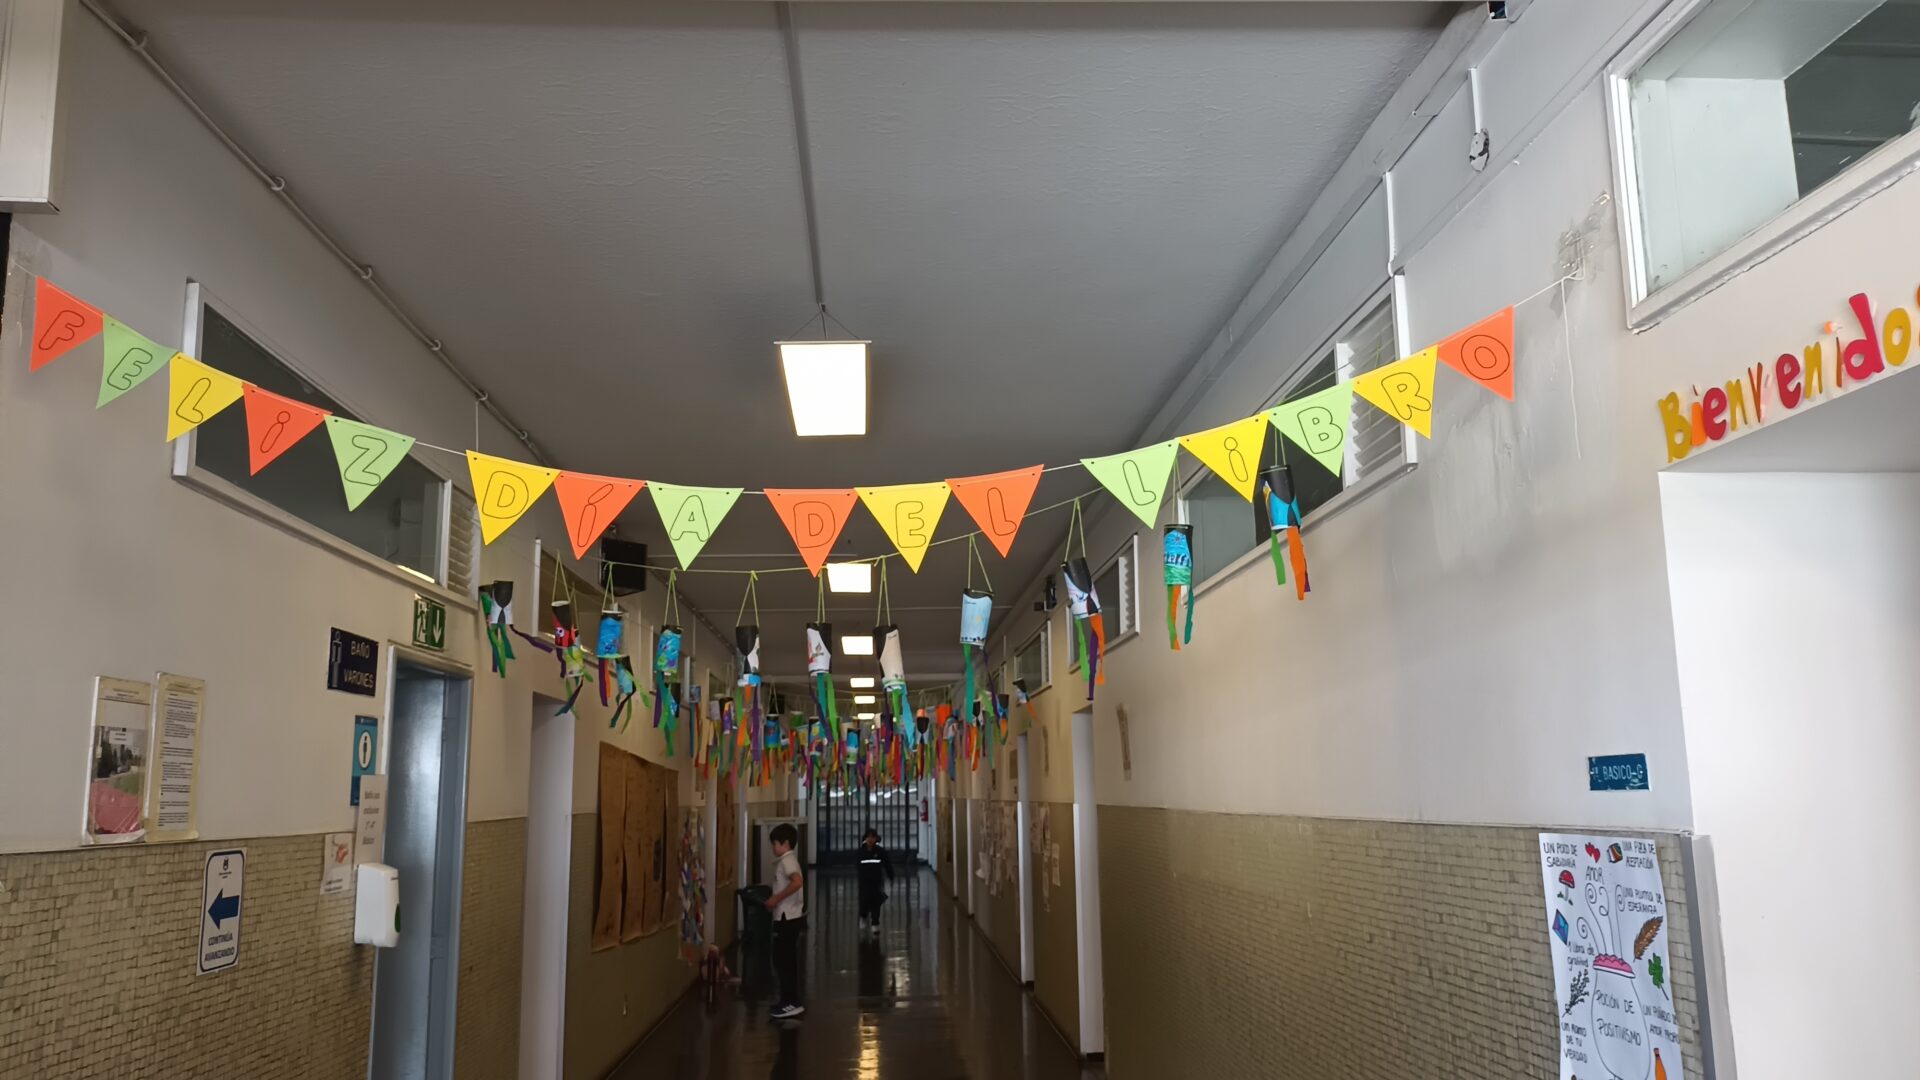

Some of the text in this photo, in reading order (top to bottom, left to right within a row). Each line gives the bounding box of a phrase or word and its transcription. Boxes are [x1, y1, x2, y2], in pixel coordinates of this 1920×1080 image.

[1658, 284, 1920, 463] Bienvenido
[793, 487, 1018, 549] DEL
[350, 640, 370, 659] BAÑO
[343, 668, 374, 689] VARONES
[1543, 842, 1555, 854] UN
[1585, 865, 1604, 884] AMOR
[203, 946, 235, 962] AVANZANDO
[1623, 999, 1635, 1014] DE
[1596, 1018, 1642, 1047] POSITIVISMO
